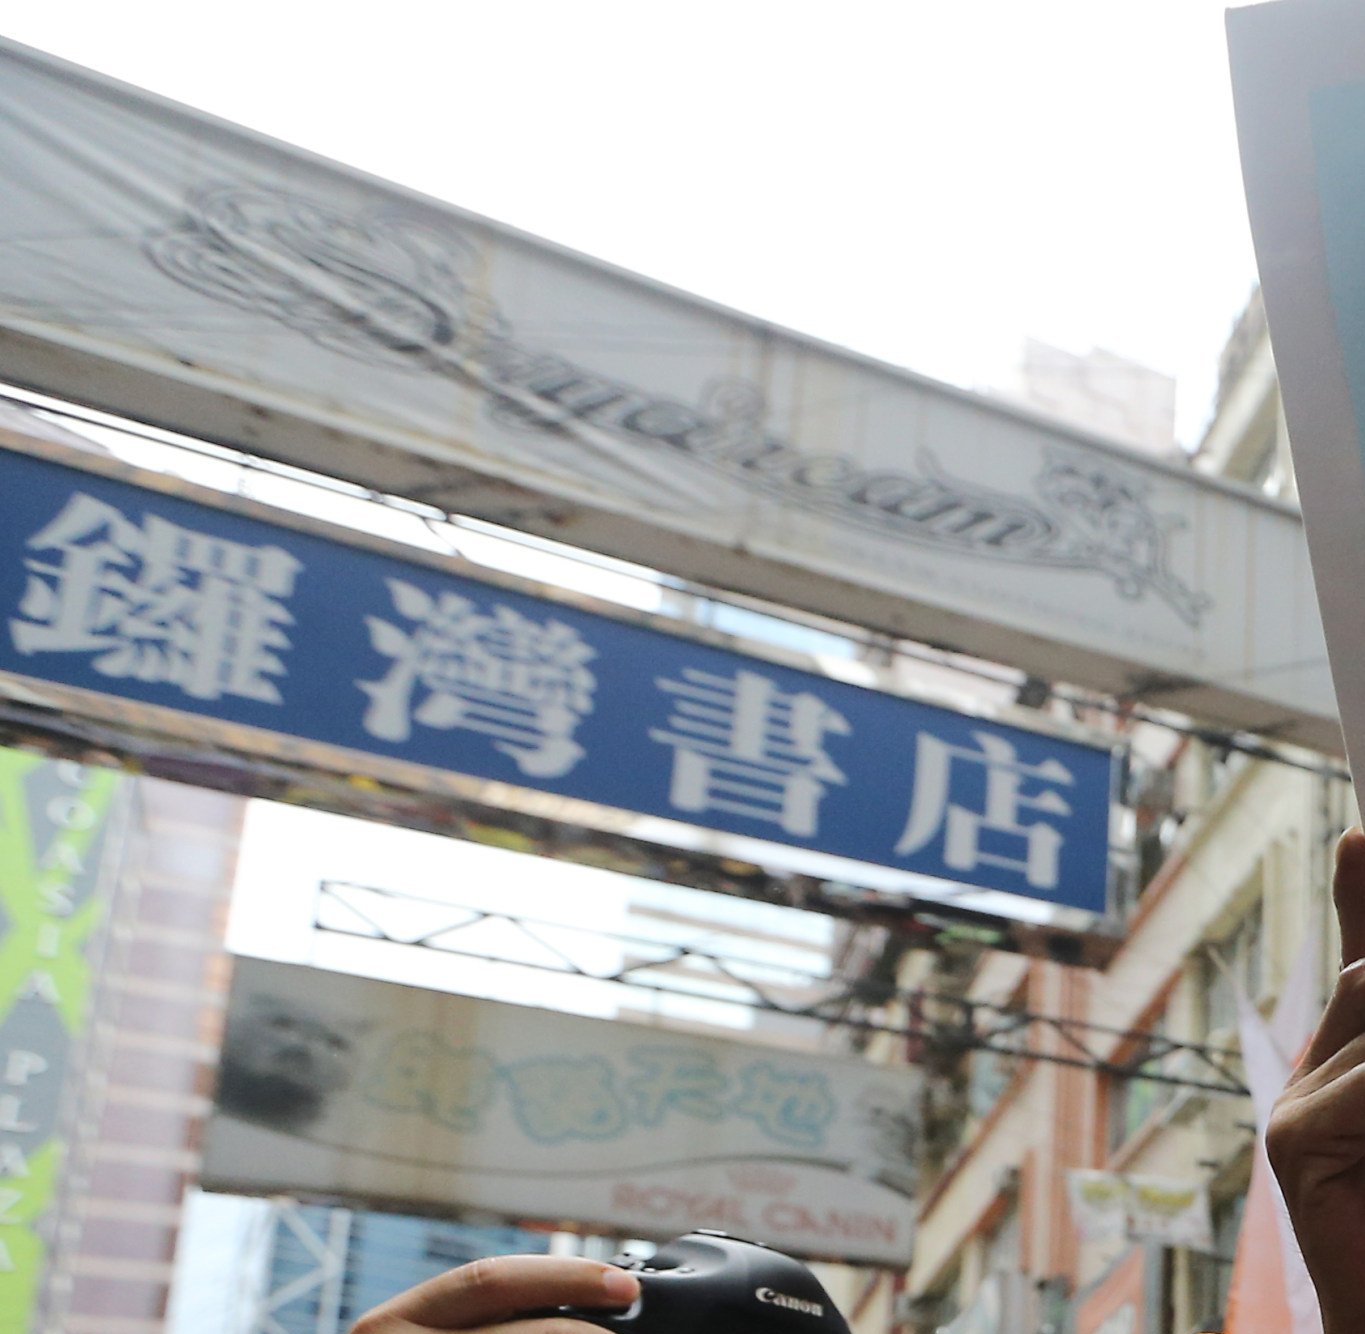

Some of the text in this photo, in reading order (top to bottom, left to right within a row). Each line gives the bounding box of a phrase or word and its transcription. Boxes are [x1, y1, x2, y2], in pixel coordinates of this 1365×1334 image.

[9, 492, 1074, 890] 鑼灣書店
[611, 1181, 899, 1243] ROYAL CANIN
[755, 1286, 824, 1318] Canon
